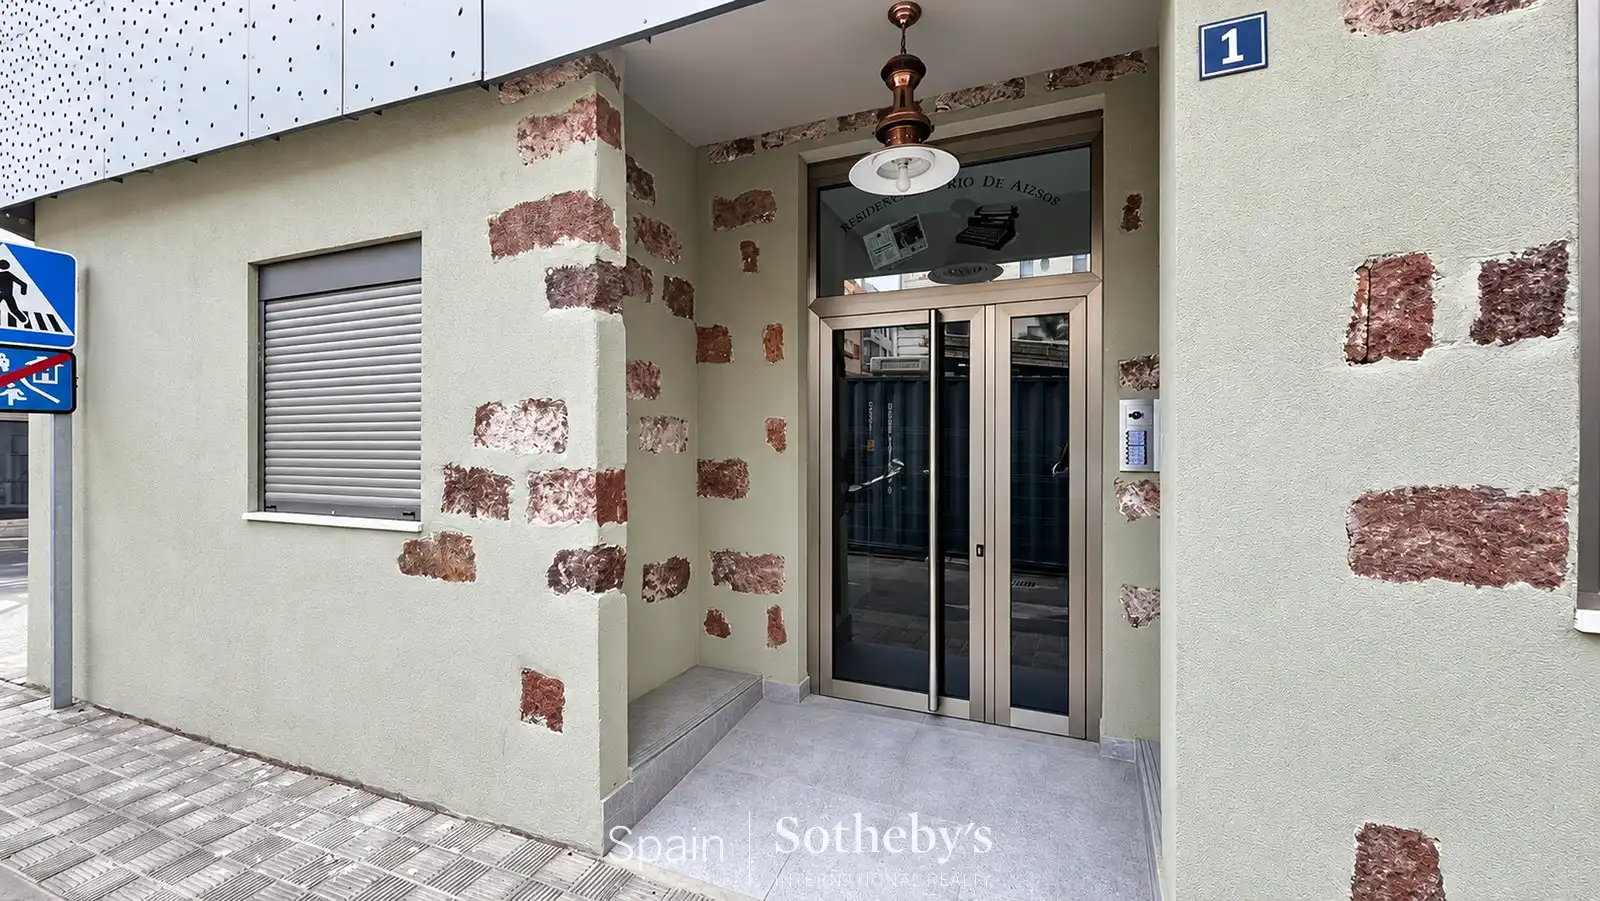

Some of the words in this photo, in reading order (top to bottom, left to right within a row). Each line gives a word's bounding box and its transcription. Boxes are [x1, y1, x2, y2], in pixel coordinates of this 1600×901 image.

[1221, 27, 1244, 65] 1
[840, 193, 911, 233] RESIDENC
[983, 175, 1005, 188] DE
